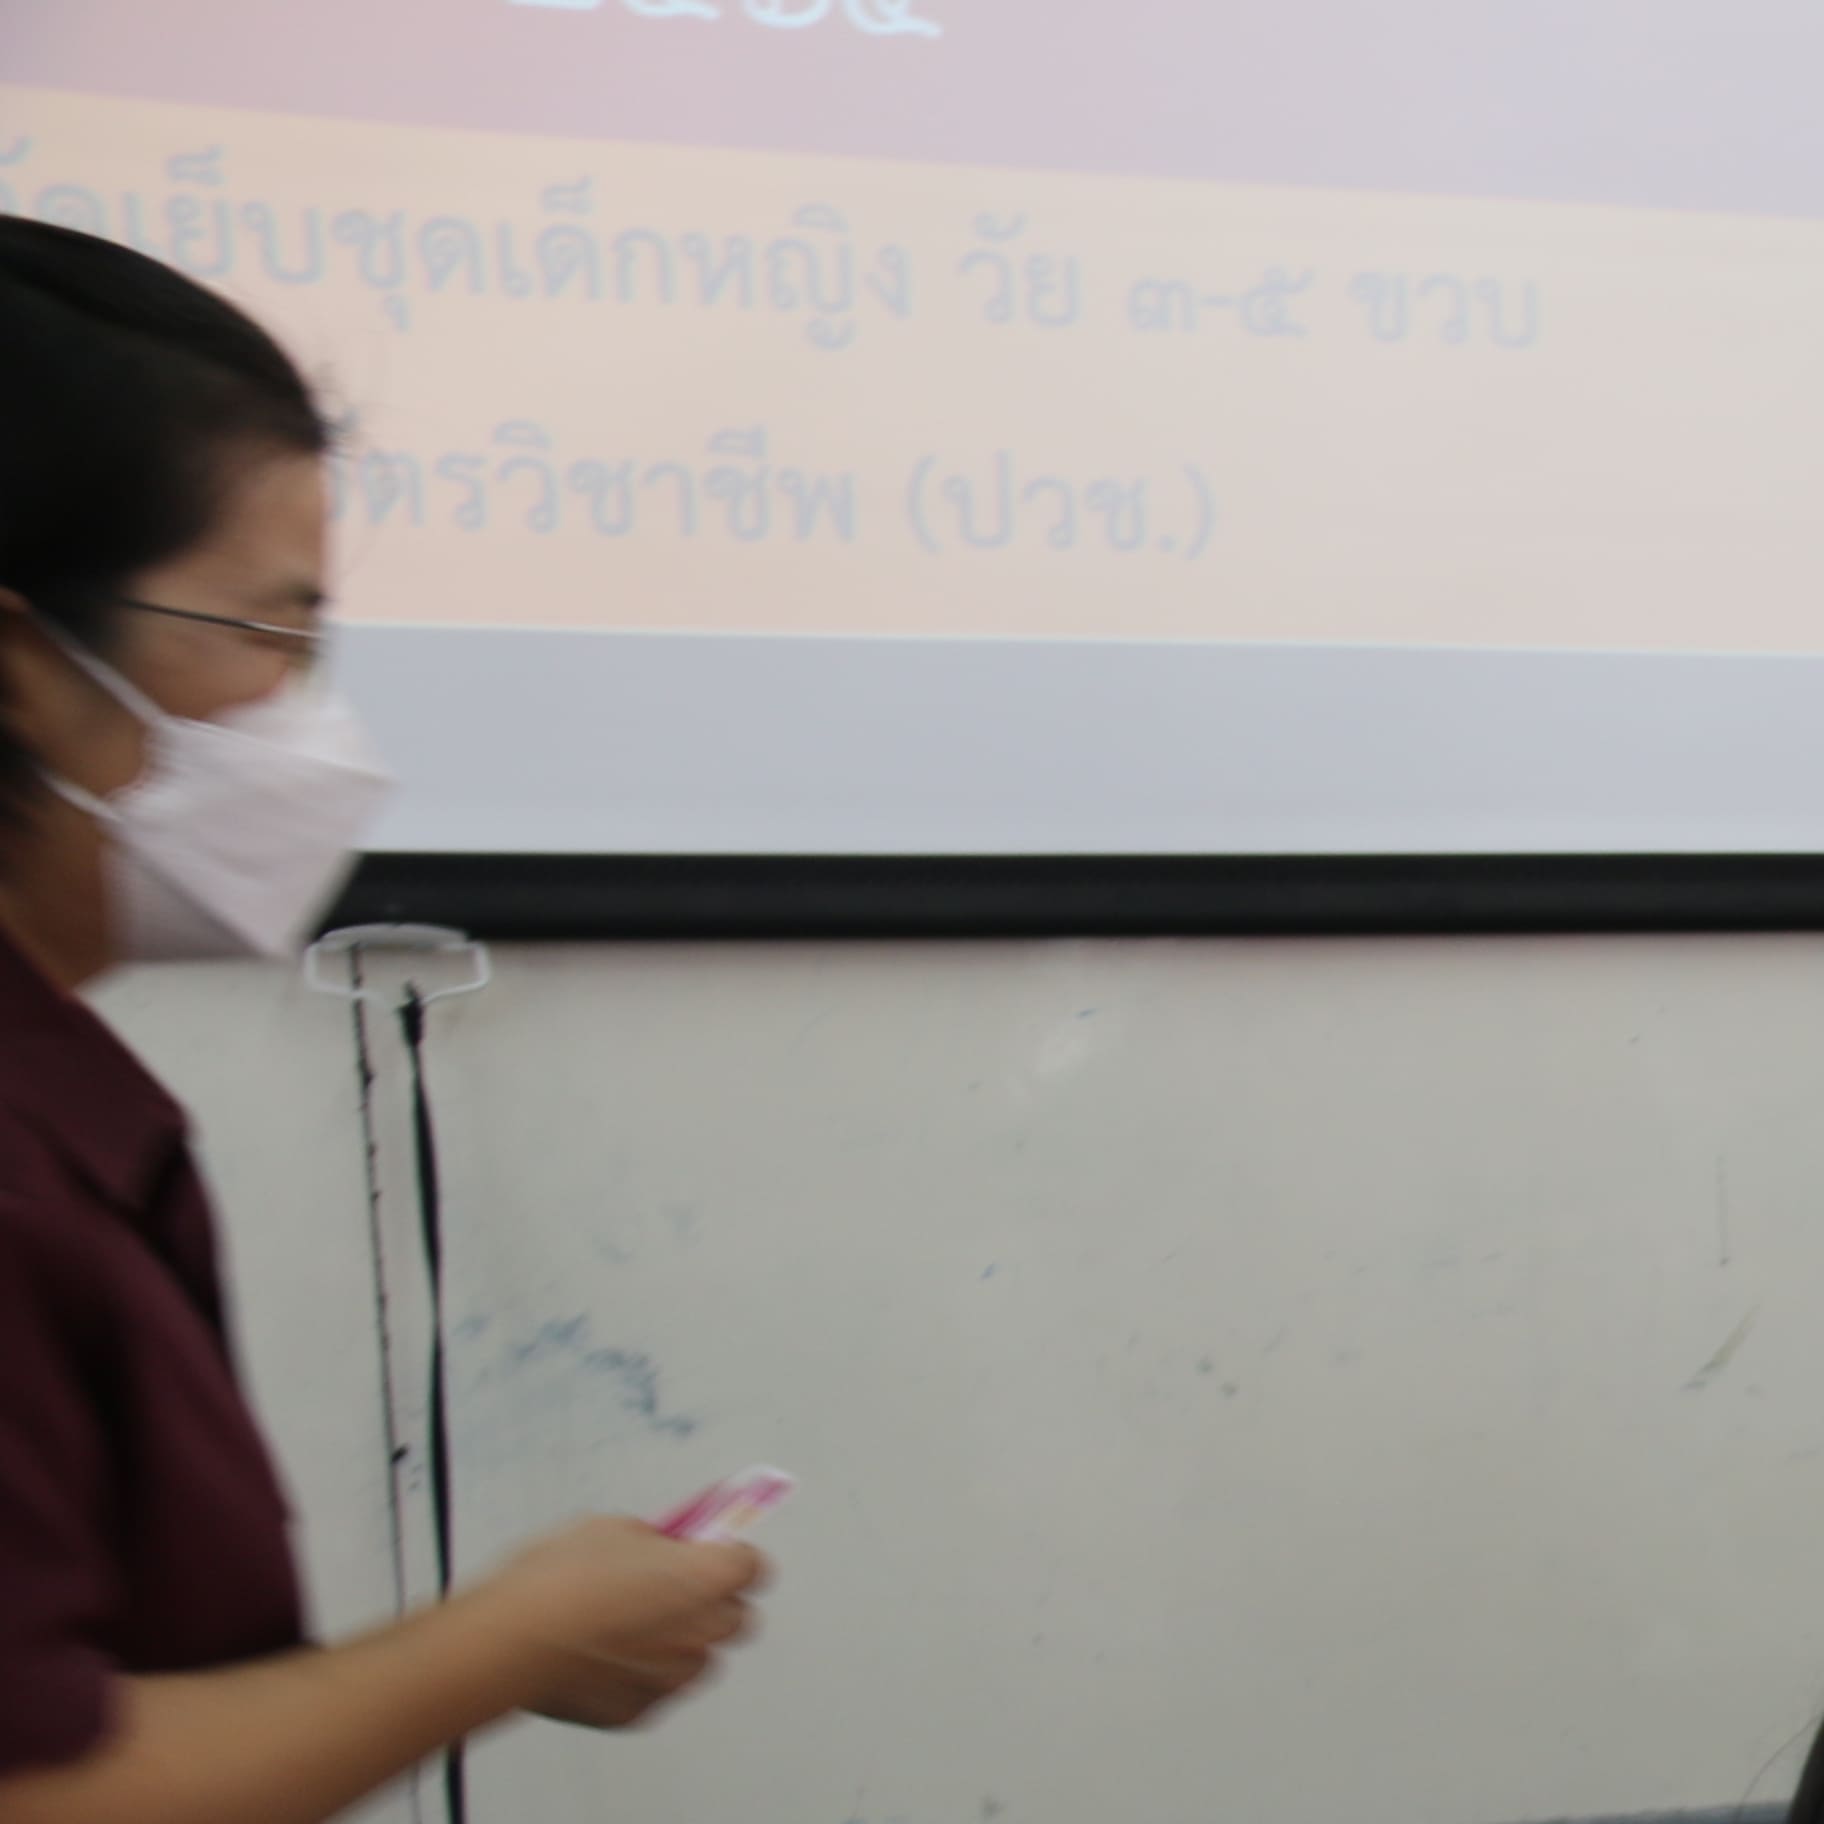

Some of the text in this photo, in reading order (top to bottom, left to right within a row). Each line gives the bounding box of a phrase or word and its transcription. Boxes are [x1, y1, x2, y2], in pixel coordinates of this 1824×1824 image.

[957, 210, 1082, 328] วัย
[1124, 265, 1318, 338] ๓-๕
[1348, 271, 1542, 350] ขวบ
[333, 420, 1217, 561] ตรวิชาชีพ (ปวช.)
